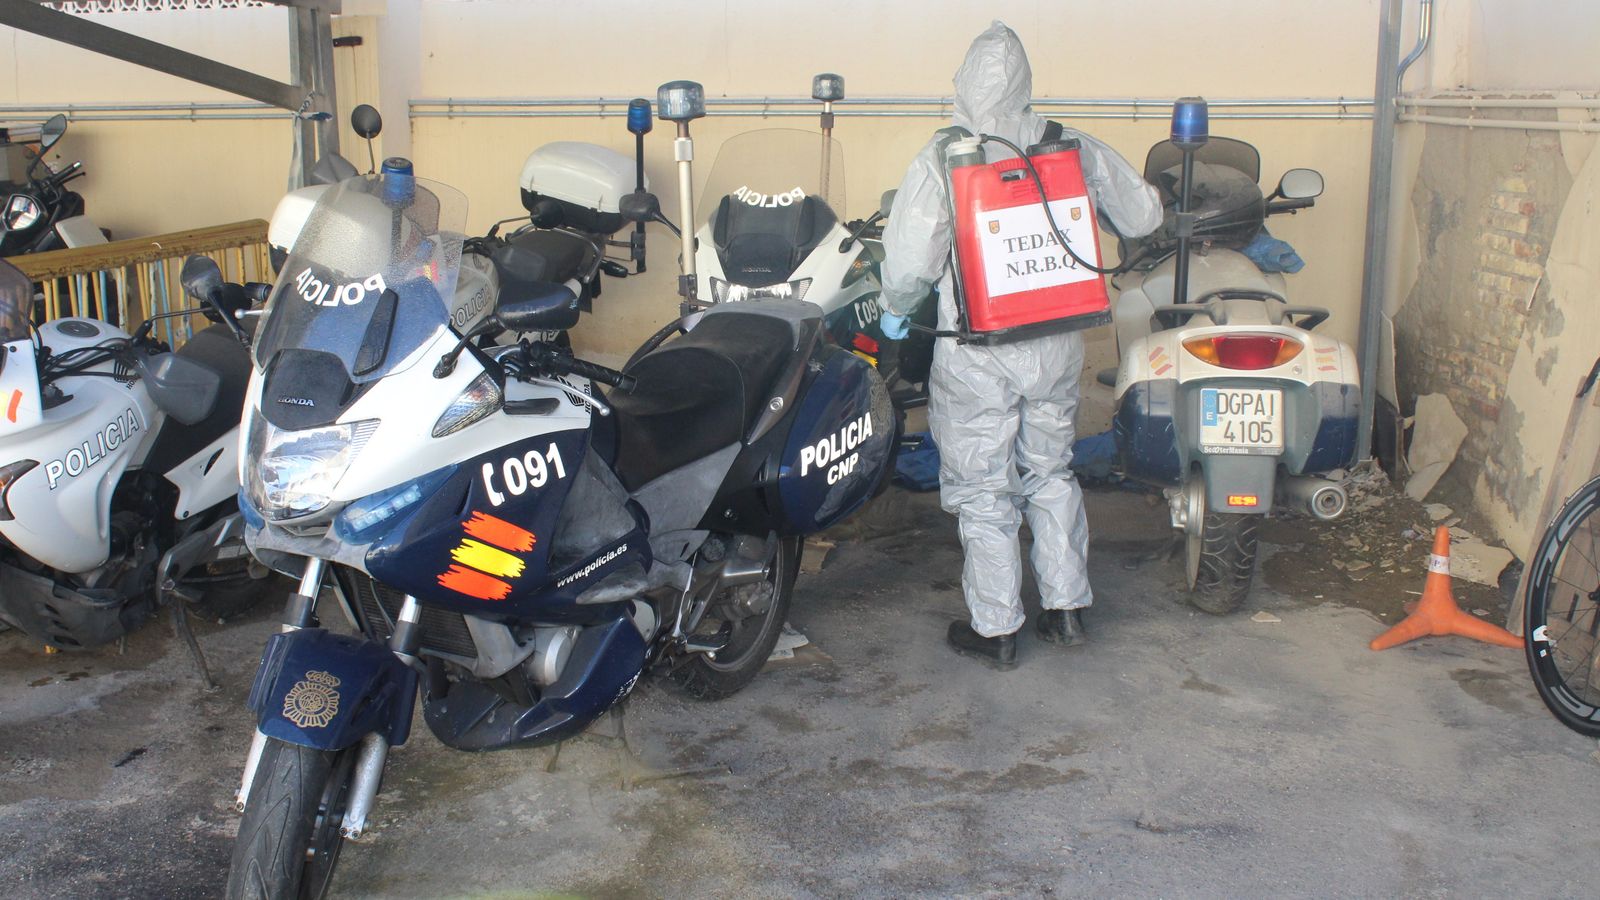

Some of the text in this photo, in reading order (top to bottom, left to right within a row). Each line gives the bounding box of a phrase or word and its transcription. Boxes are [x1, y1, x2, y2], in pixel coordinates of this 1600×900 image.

[1003, 228, 1073, 253] TEDAX
[1206, 412, 1214, 421] E
[1223, 420, 1274, 444] 4105
[44, 408, 140, 490] POLICIA
[800, 411, 873, 477] POLICIA
[502, 442, 567, 496] 091
[827, 452, 859, 485] CNP
[556, 542, 628, 589] www.policia.es
